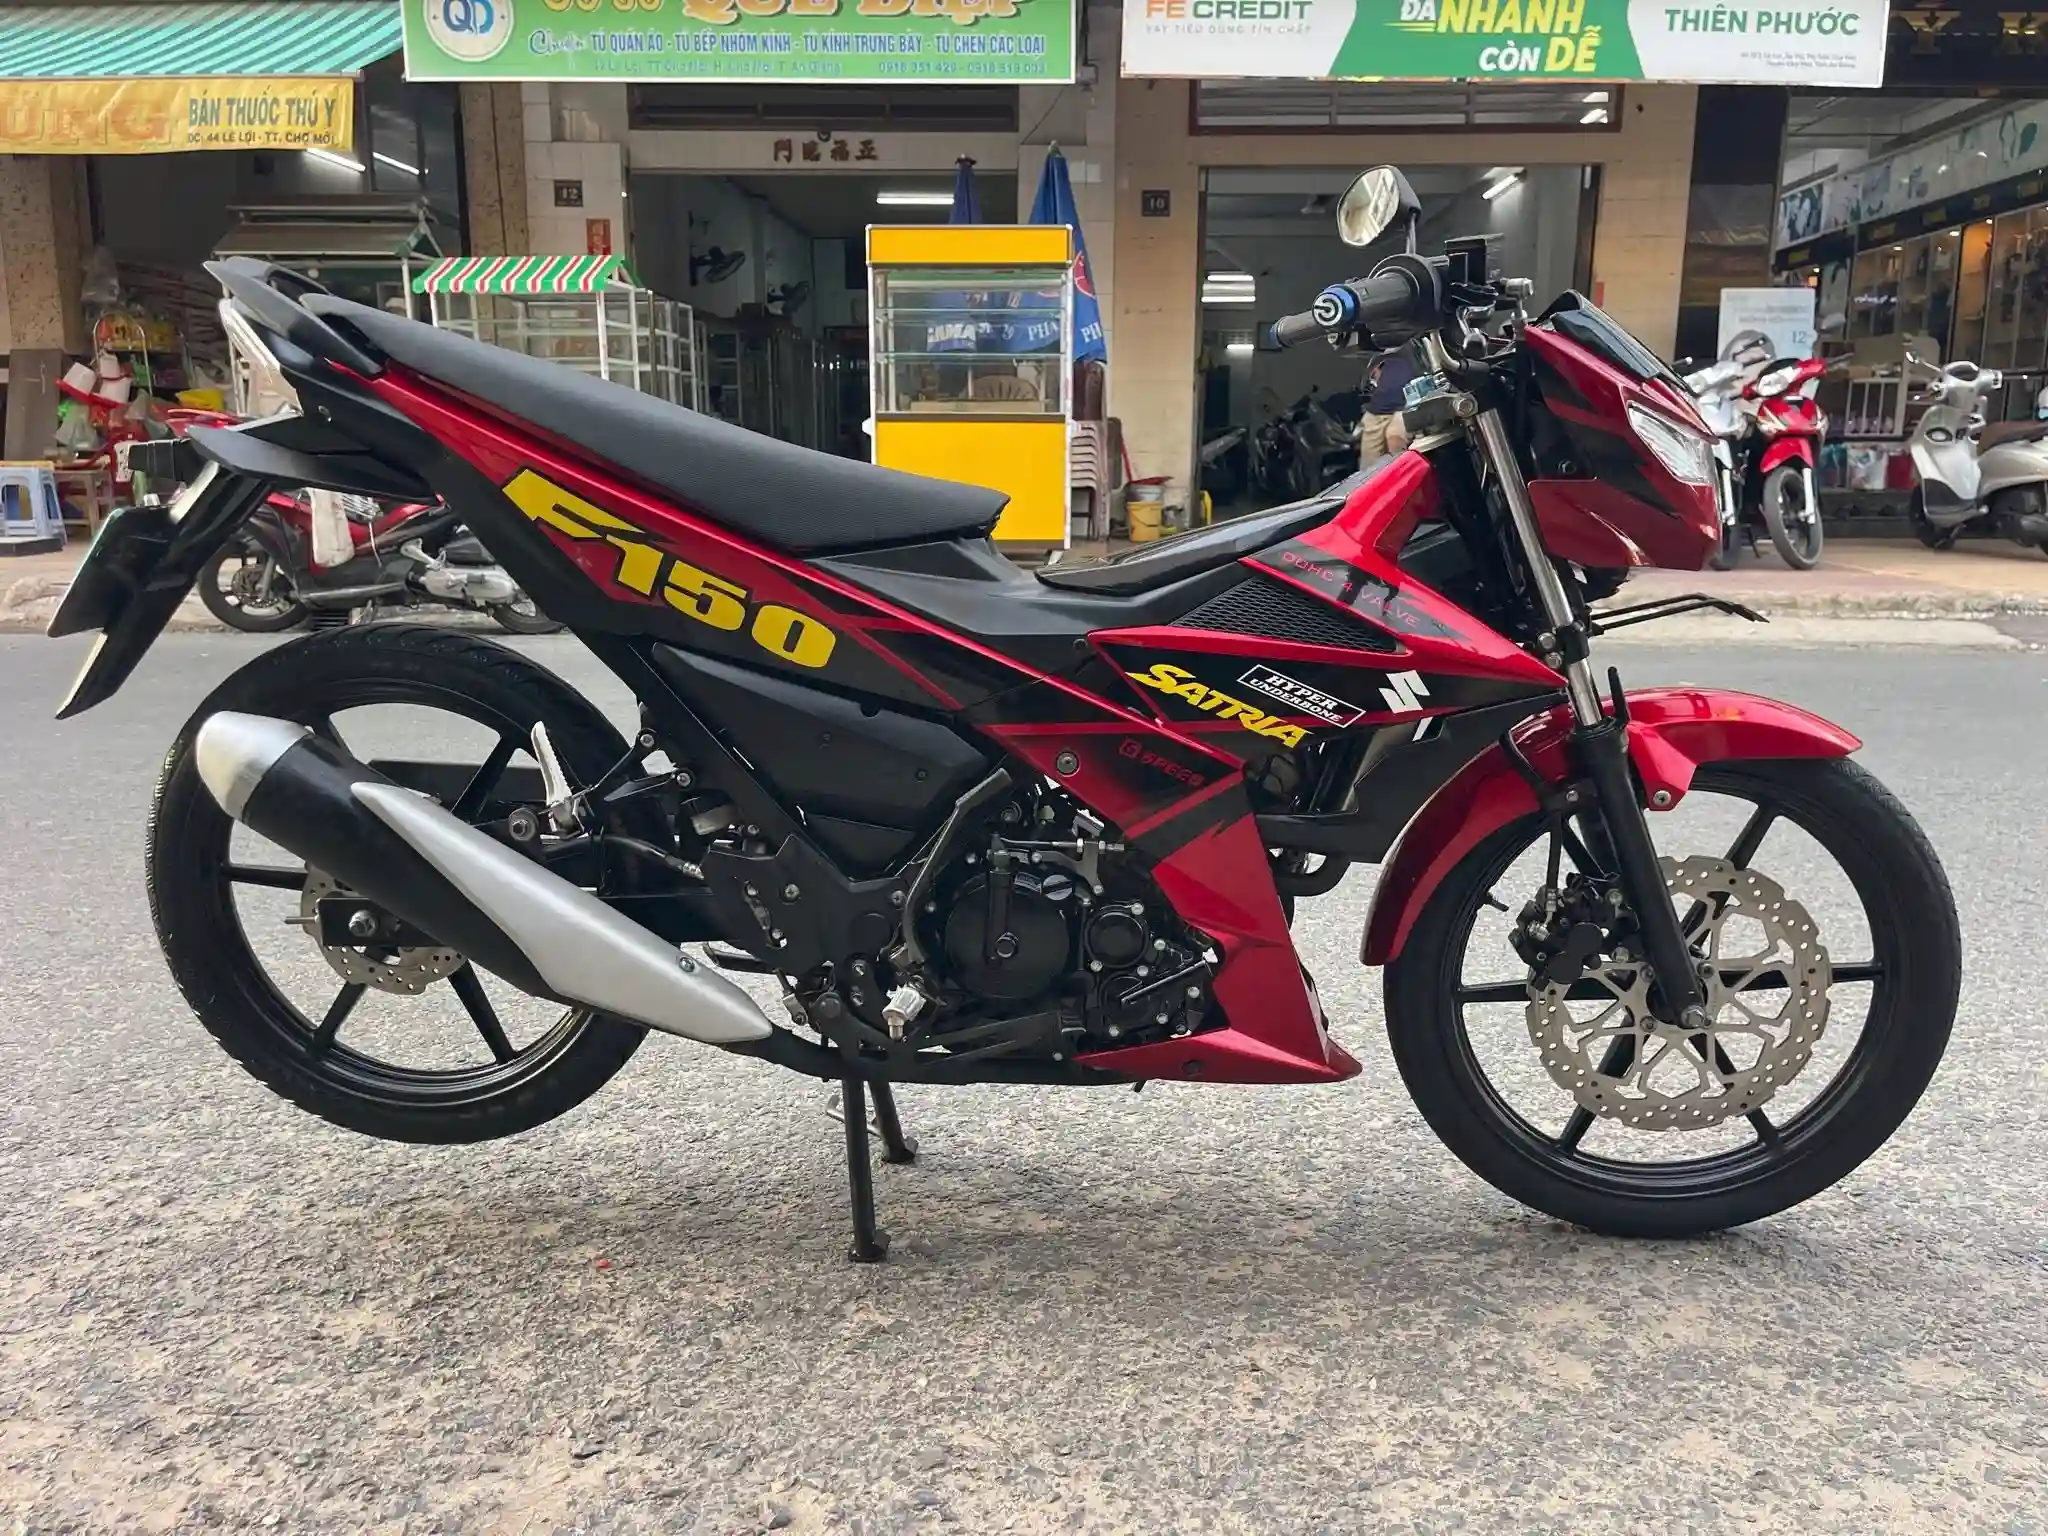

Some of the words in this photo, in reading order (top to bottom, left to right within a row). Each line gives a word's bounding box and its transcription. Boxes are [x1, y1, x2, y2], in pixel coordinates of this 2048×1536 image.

[1146, 0, 1186, 19] FE
[1193, 0, 1313, 19] CREDIT
[1436, 0, 1586, 33] NHANH
[1665, 4, 1748, 33] THIÊN
[1756, 6, 1861, 35] PHƯỚC
[1479, 40, 1541, 72] CÒN
[1544, 25, 1602, 72] DỄ
[189, 90, 221, 126] BÁN
[226, 86, 280, 126] THUỐC
[286, 90, 319, 127] THÚ
[324, 98, 336, 127] Y
[207, 133, 219, 142] 44
[1125, 663, 1315, 748] SATRIA
[1249, 678, 1344, 722] UNDERBONE
[1265, 675, 1338, 710] HYPER
